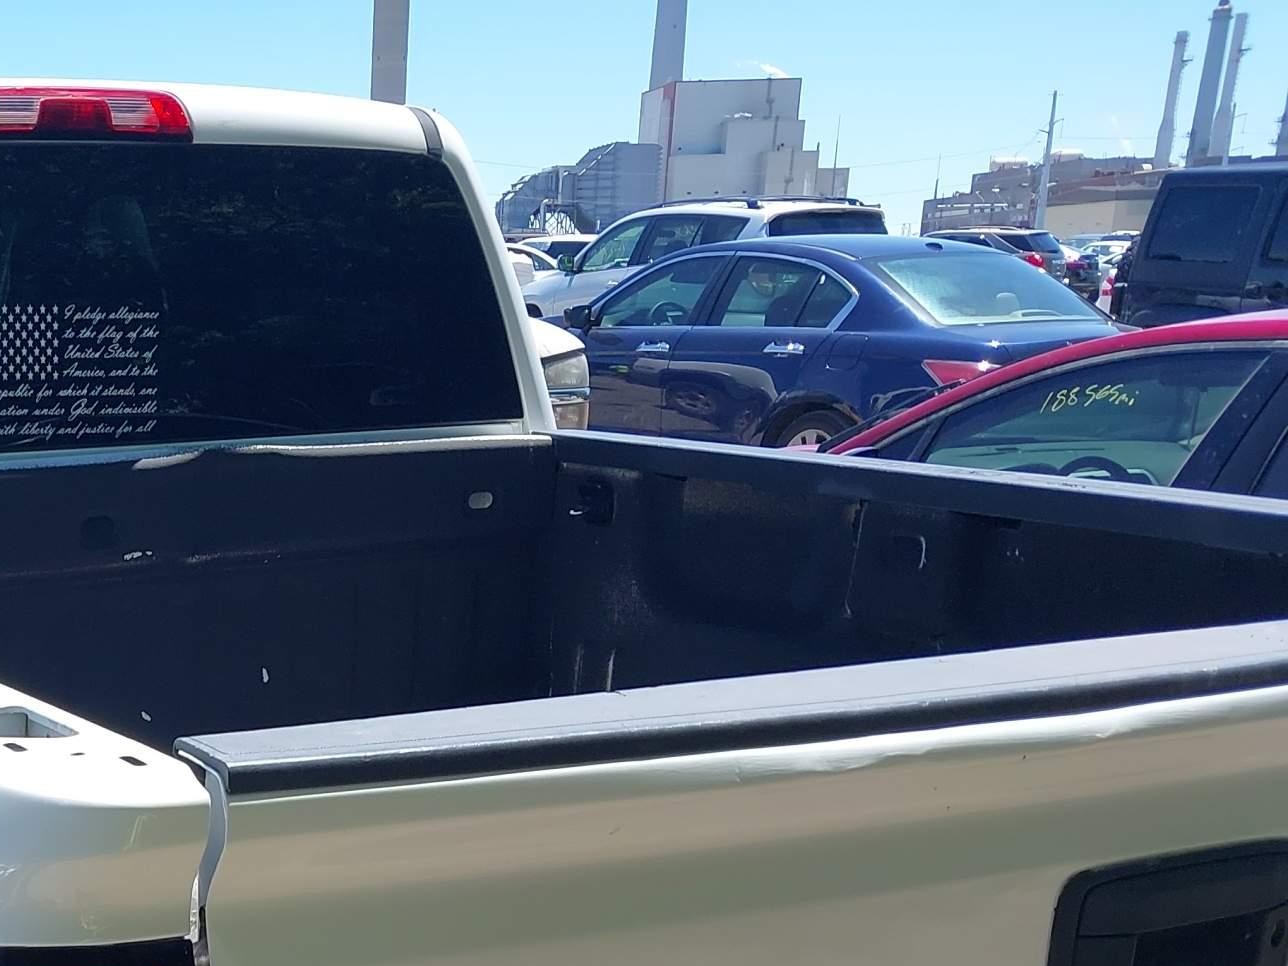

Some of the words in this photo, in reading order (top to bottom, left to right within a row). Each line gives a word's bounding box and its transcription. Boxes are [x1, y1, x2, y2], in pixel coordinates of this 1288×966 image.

[73, 306, 106, 324] pledge
[108, 306, 159, 324] allegiance
[62, 327, 75, 338] to
[78, 326, 96, 338] the
[97, 325, 123, 343] flag
[126, 326, 138, 343] of
[140, 325, 159, 338] the
[64, 345, 105, 358] United
[104, 343, 139, 358] States
[142, 345, 158, 362] of
[63, 362, 106, 378] America,
[108, 364, 127, 376] and
[129, 365, 139, 376] to
[142, 364, 158, 376] the
[36, 383, 53, 402] for
[56, 383, 89, 397] which
[89, 385, 102, 396] it
[102, 382, 135, 397] stands,
[32, 402, 65, 415] under
[68, 398, 98, 421] God,
[101, 400, 157, 415] indivisible
[18, 422, 55, 440] liberty
[56, 421, 82, 434] and
[77, 423, 115, 439] justice
[115, 420, 132, 438] for
[135, 420, 157, 432] all
